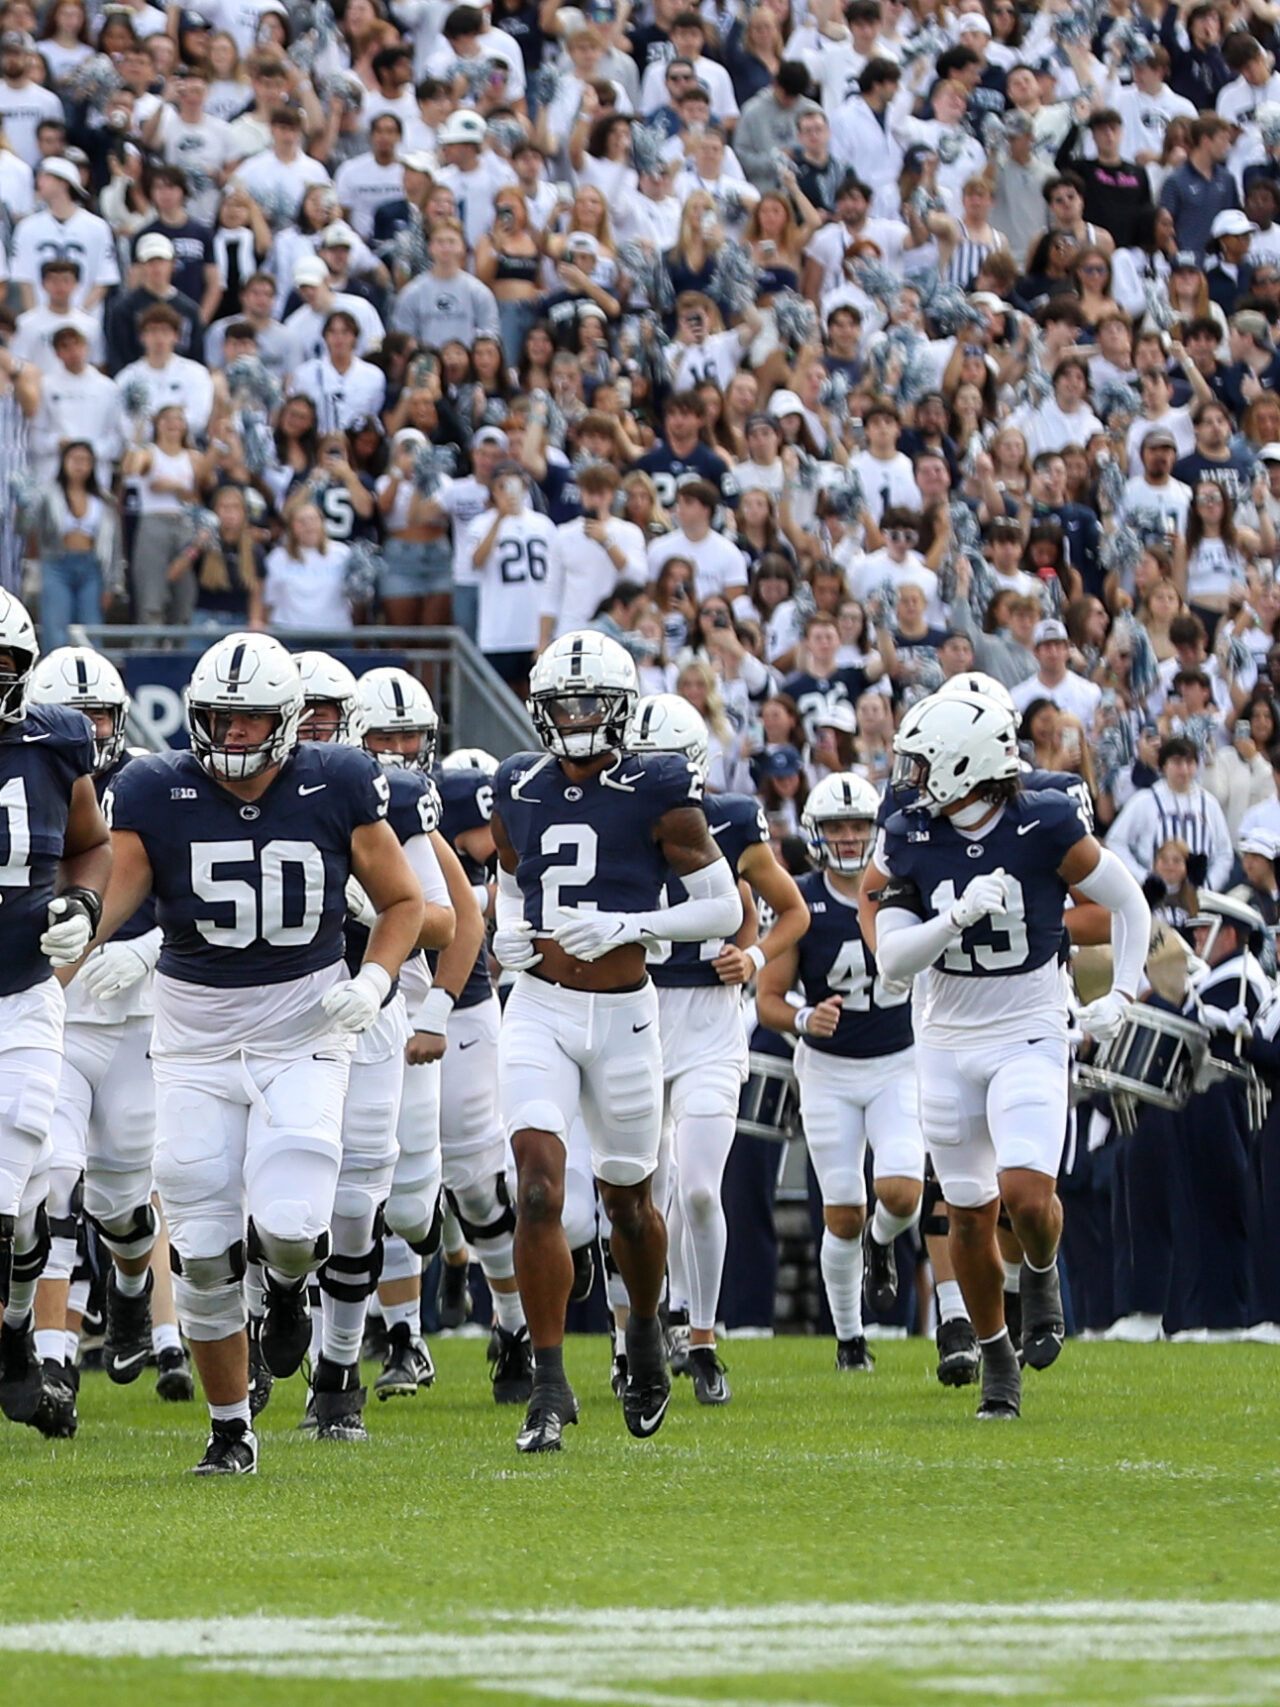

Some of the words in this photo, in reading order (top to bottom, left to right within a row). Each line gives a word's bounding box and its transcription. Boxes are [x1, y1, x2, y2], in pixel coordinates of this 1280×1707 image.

[499, 538, 548, 583] 26
[190, 839, 325, 949] 50
[540, 823, 598, 931] 2
[930, 873, 1030, 972] 13
